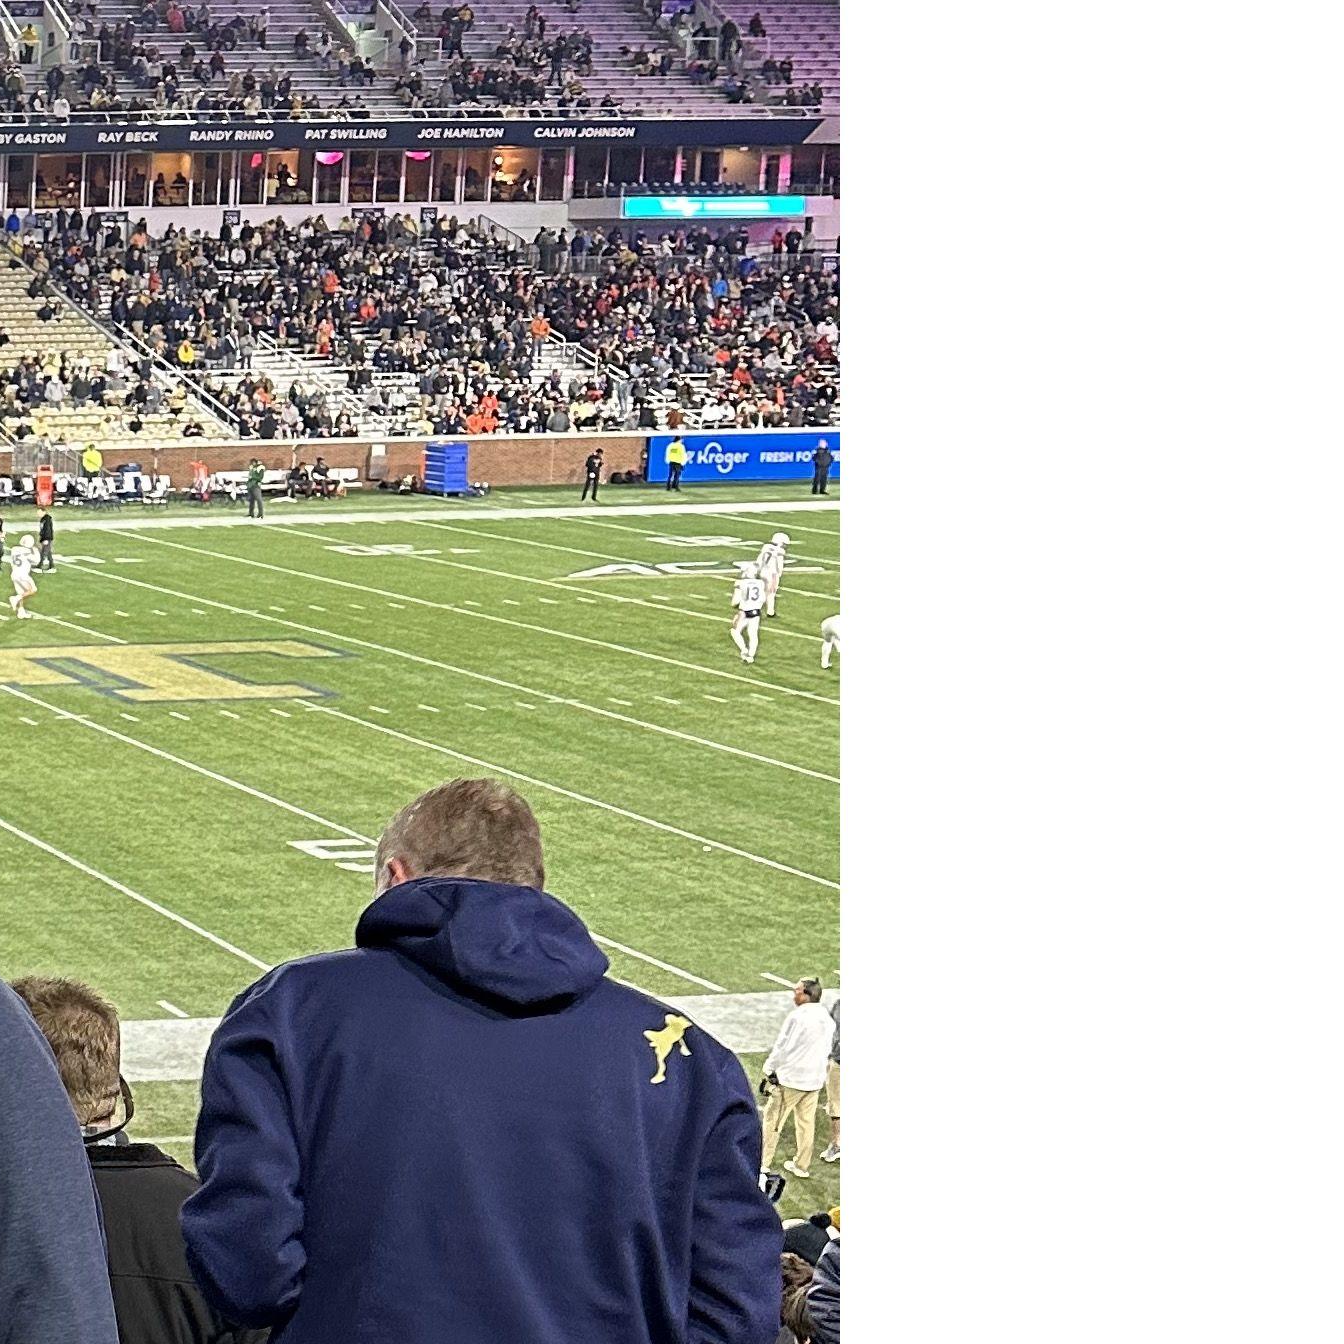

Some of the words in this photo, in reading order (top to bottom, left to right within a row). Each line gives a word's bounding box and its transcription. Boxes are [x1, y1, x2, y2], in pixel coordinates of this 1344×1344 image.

[97, 131, 125, 143] RAY
[125, 131, 159, 143] BECK
[189, 129, 233, 142] RANDY
[234, 129, 275, 142] RHINO
[304, 128, 328, 140] PAT
[329, 128, 388, 140] SWILLING
[417, 127, 442, 139] JOE
[443, 127, 505, 139] HAMILTON
[533, 126, 577, 138] CALVIN
[578, 126, 636, 138] JOHNSON
[14, 132, 67, 145] GASTON
[697, 442, 750, 474] Kroger
[760, 451, 794, 463] FRESH
[795, 451, 816, 463] FO
[744, 587, 760, 601] 13
